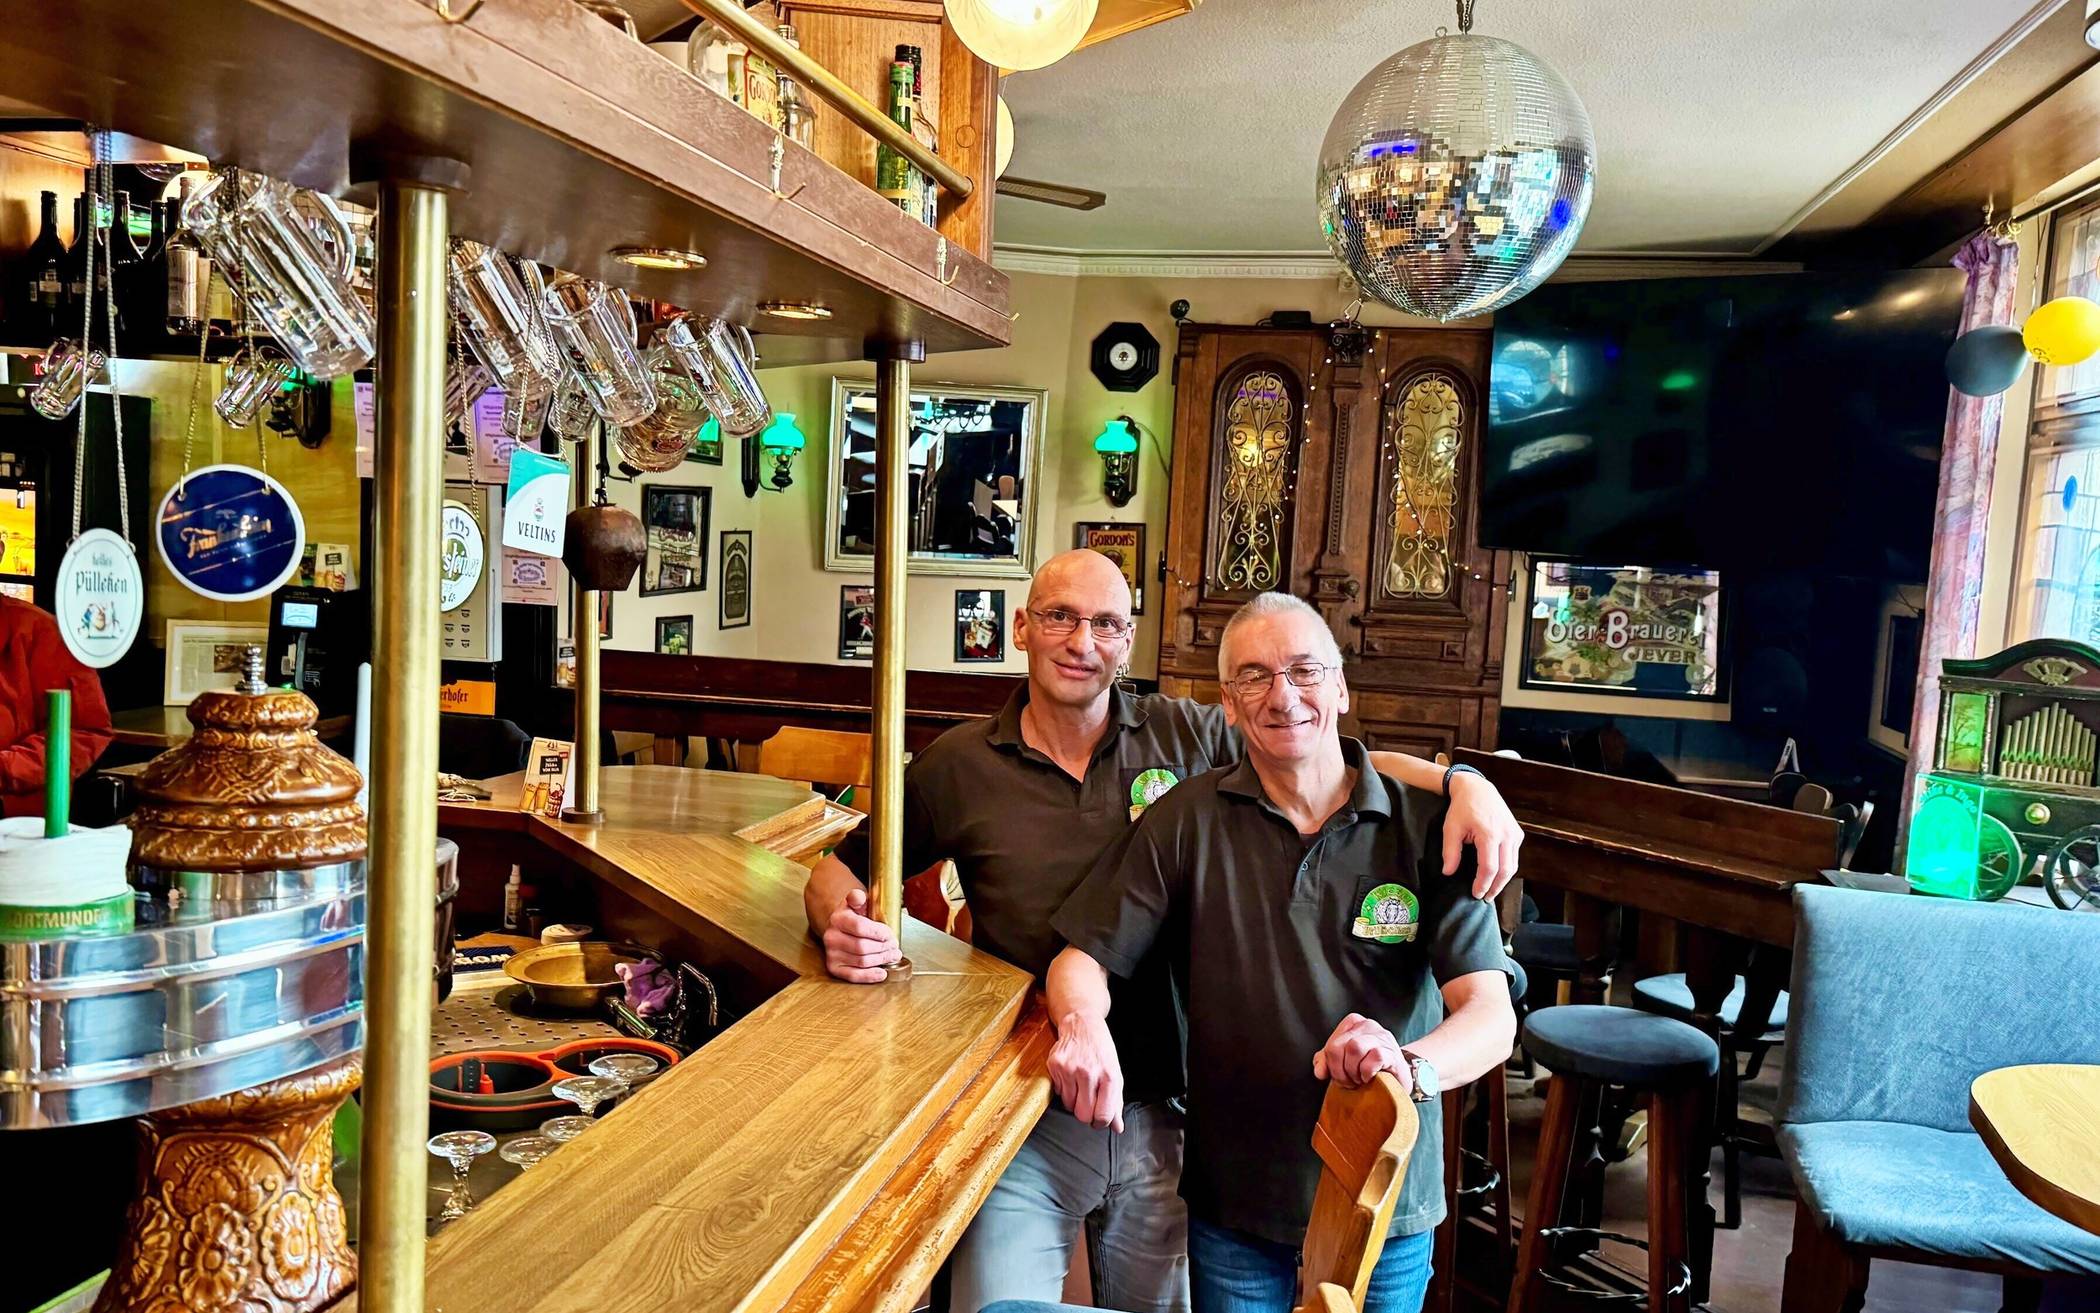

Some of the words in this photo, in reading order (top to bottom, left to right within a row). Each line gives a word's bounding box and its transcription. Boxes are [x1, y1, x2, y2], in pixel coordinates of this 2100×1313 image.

[518, 521, 556, 543] VELTINS
[1090, 531, 1135, 547] GORDON'S
[1626, 649, 1697, 664] JEVER
